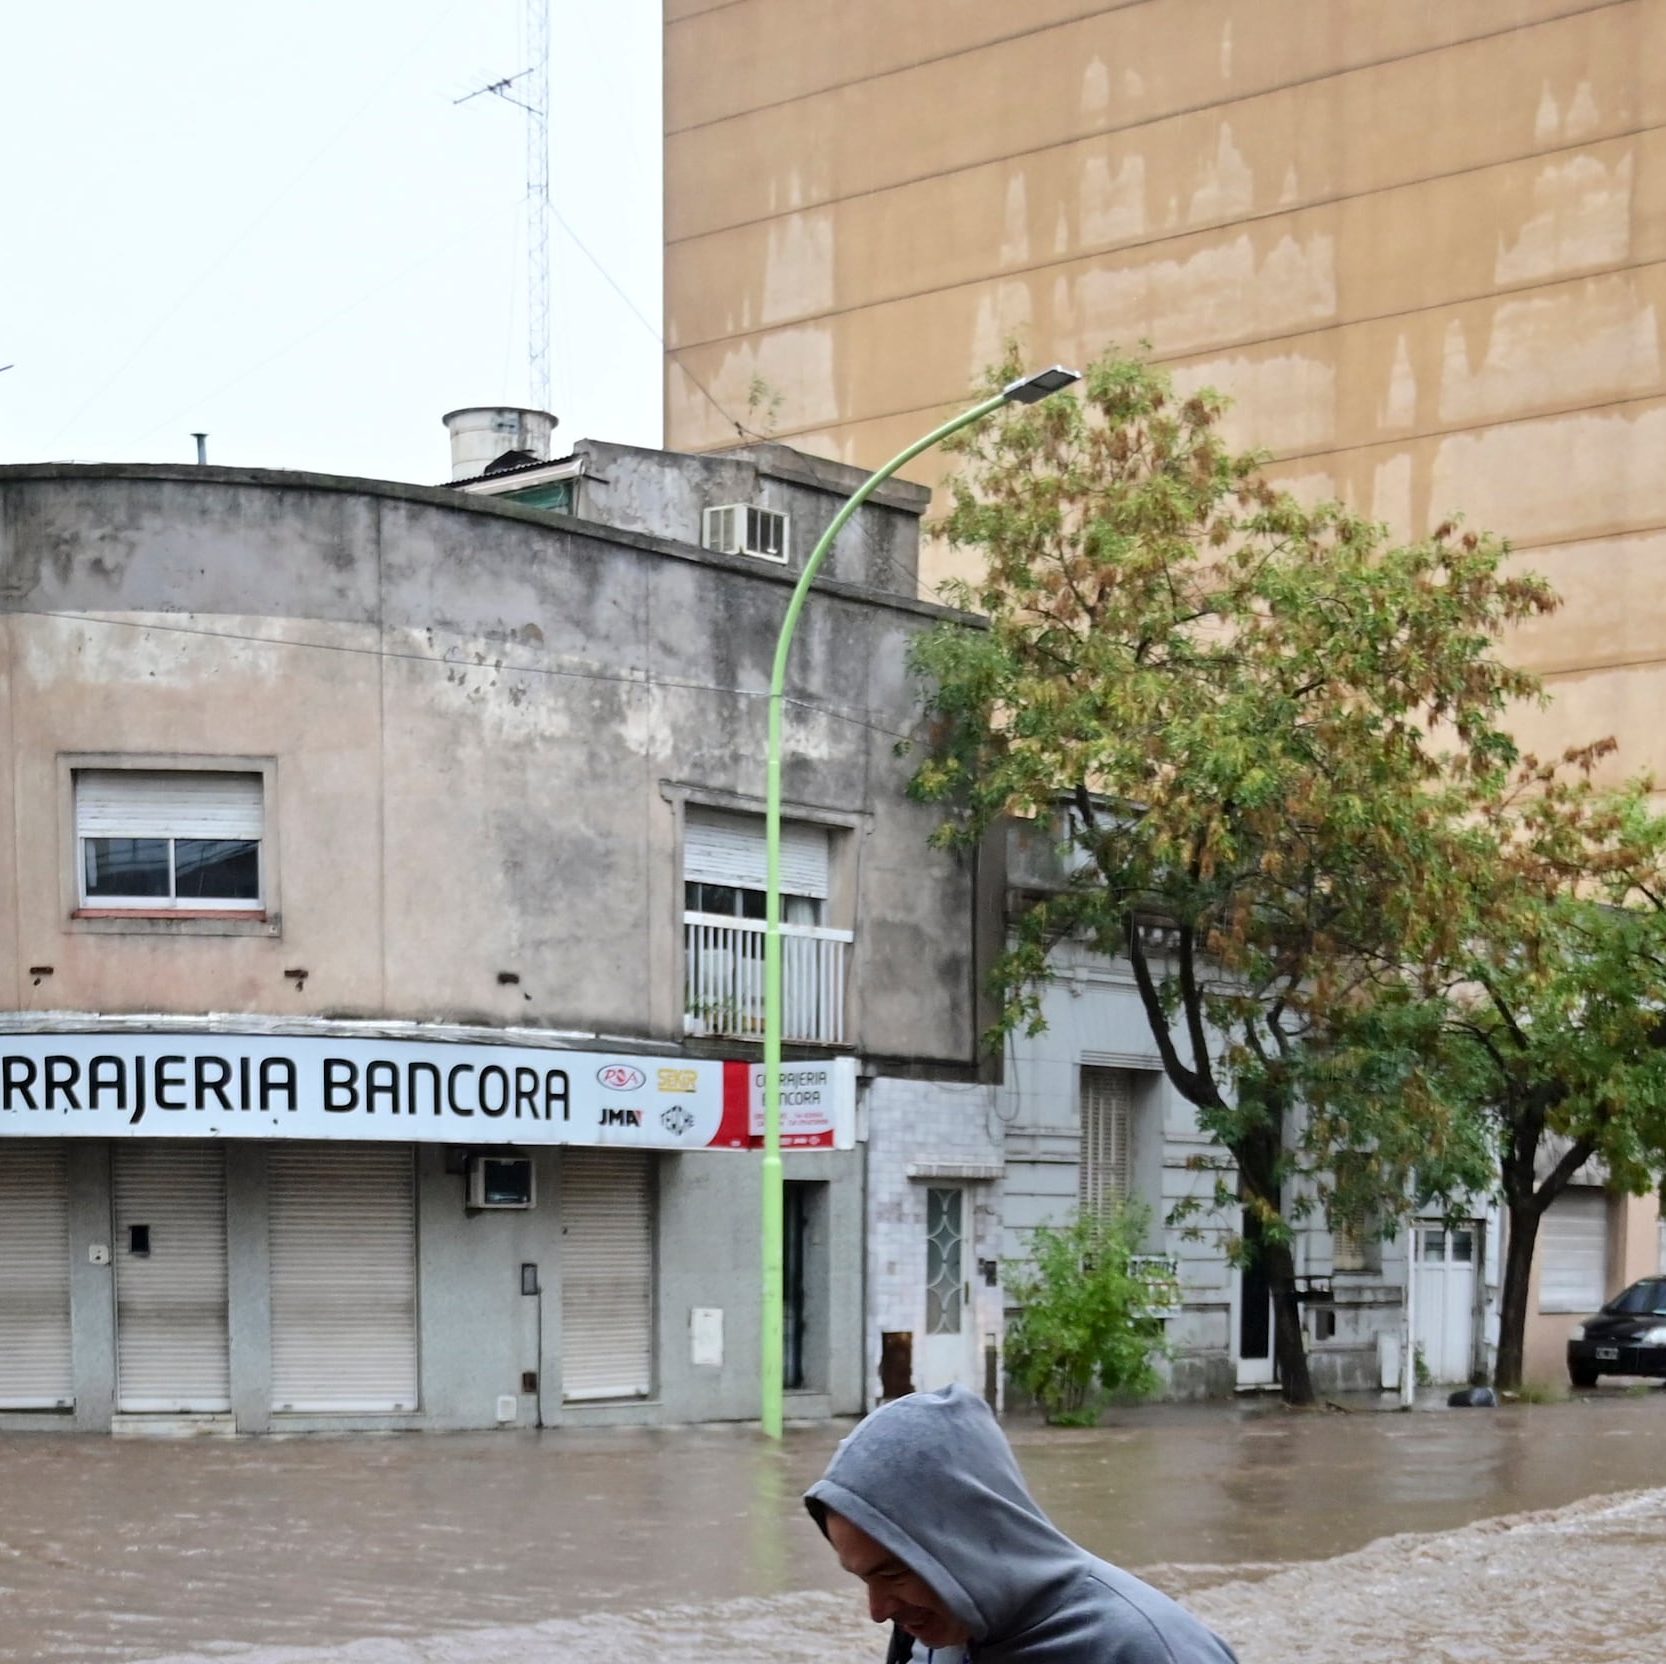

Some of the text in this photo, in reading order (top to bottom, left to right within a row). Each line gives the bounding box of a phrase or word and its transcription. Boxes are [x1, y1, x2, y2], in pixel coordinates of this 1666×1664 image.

[323, 1058, 571, 1121] BANCORA
[755, 1071, 827, 1089] CRAJERIA
[598, 1108, 641, 1127] JMA
